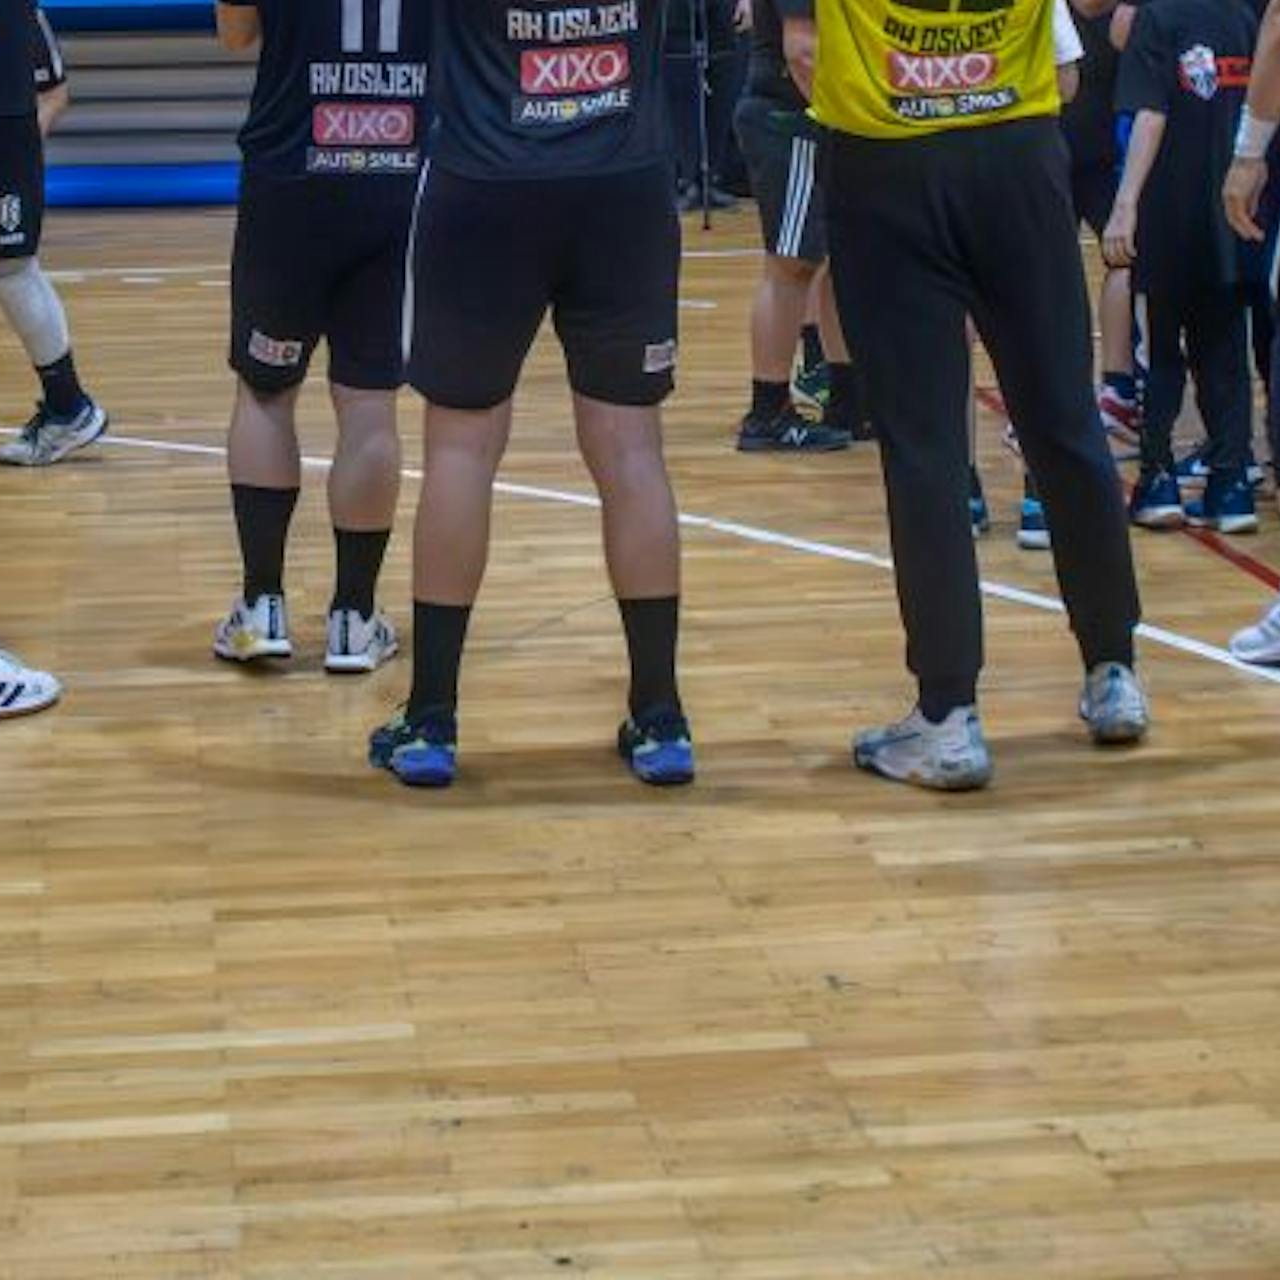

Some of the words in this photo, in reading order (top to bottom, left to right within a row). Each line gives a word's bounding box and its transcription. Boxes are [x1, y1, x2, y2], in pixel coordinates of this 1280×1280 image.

[547, 0, 639, 43] OSIJEK
[343, 62, 427, 96] OSIJEK
[533, 50, 620, 90] XIXO
[896, 53, 992, 88] XIXO
[322, 109, 409, 140] XIXO
